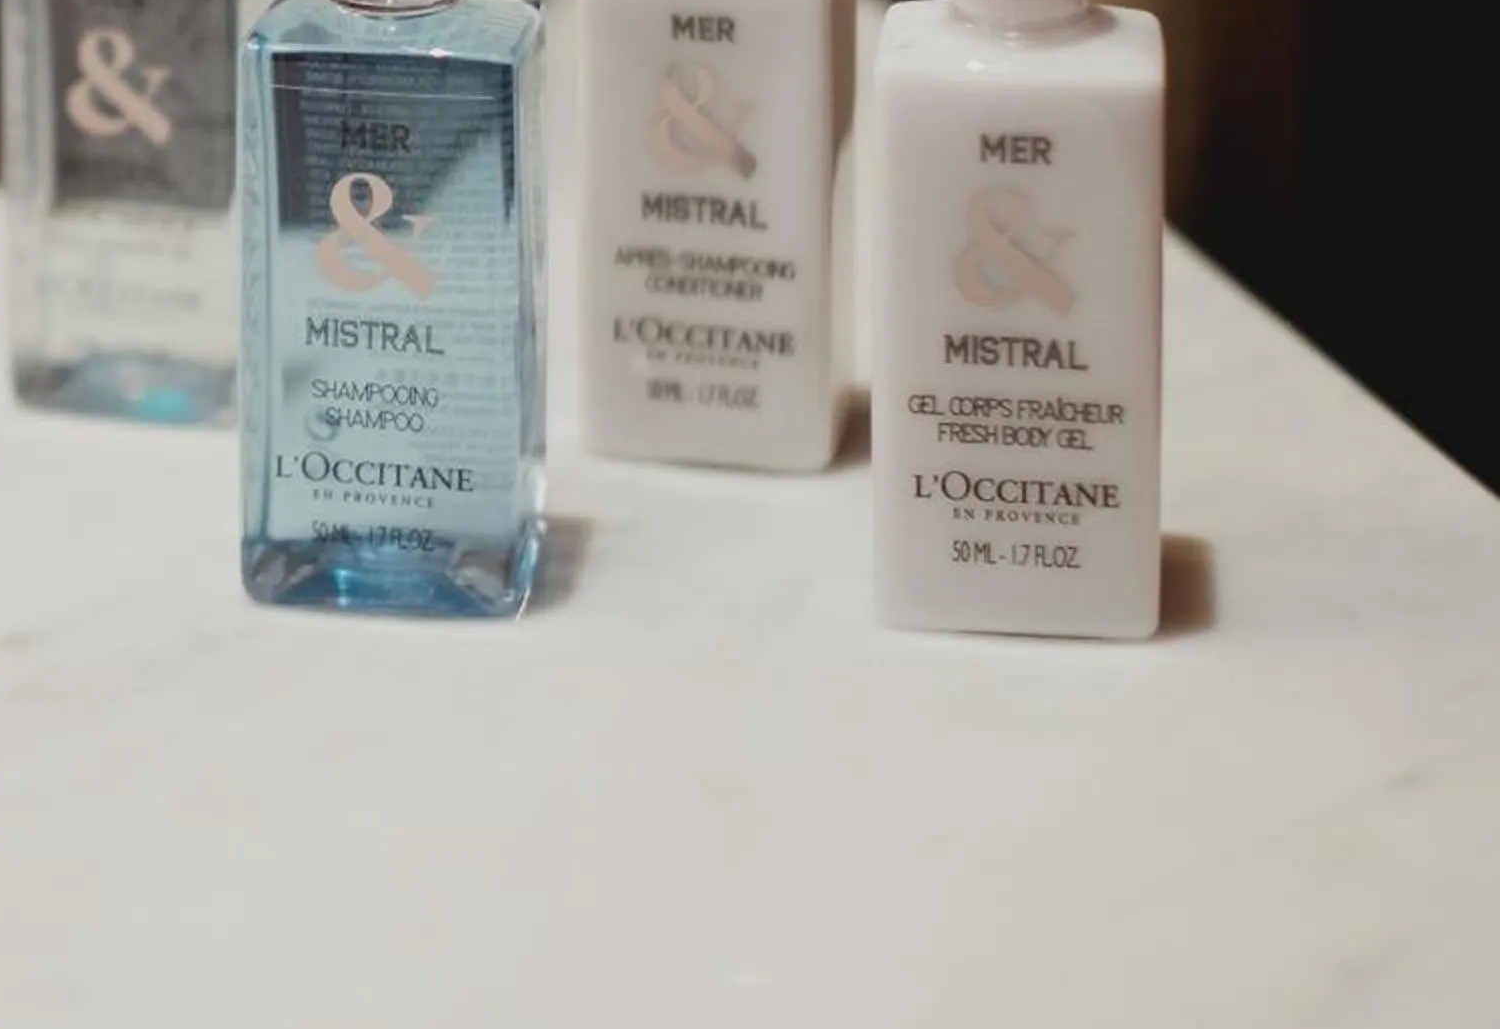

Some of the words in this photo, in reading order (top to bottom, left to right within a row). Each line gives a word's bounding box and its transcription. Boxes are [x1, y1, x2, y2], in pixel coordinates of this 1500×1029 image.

[671, 13, 736, 44] MER
[341, 121, 411, 153] MER
[979, 134, 1053, 166] MER
[641, 191, 768, 231] MISTRAL
[314, 173, 437, 300] &
[306, 316, 446, 356] MISTRAL
[612, 315, 796, 357] L'OCCITANE
[943, 334, 1089, 372] MISTRAL
[311, 378, 439, 409] SHAMPOOING
[907, 394, 945, 416] GEL
[949, 395, 1013, 419] CORPS
[324, 406, 424, 433] SHAMPOO
[937, 422, 999, 445] FRESH
[1002, 425, 1052, 448] BODY
[1056, 428, 1094, 451] GEL
[275, 451, 475, 493] L'OCCITANE
[313, 489, 333, 501] EN
[343, 491, 435, 509] PROVENCE
[913, 470, 1122, 509] L'OCCITANE
[953, 507, 975, 521] EN
[985, 509, 1081, 526] PROVENCE
[952, 540, 971, 563] 50
[973, 541, 997, 565] ML
